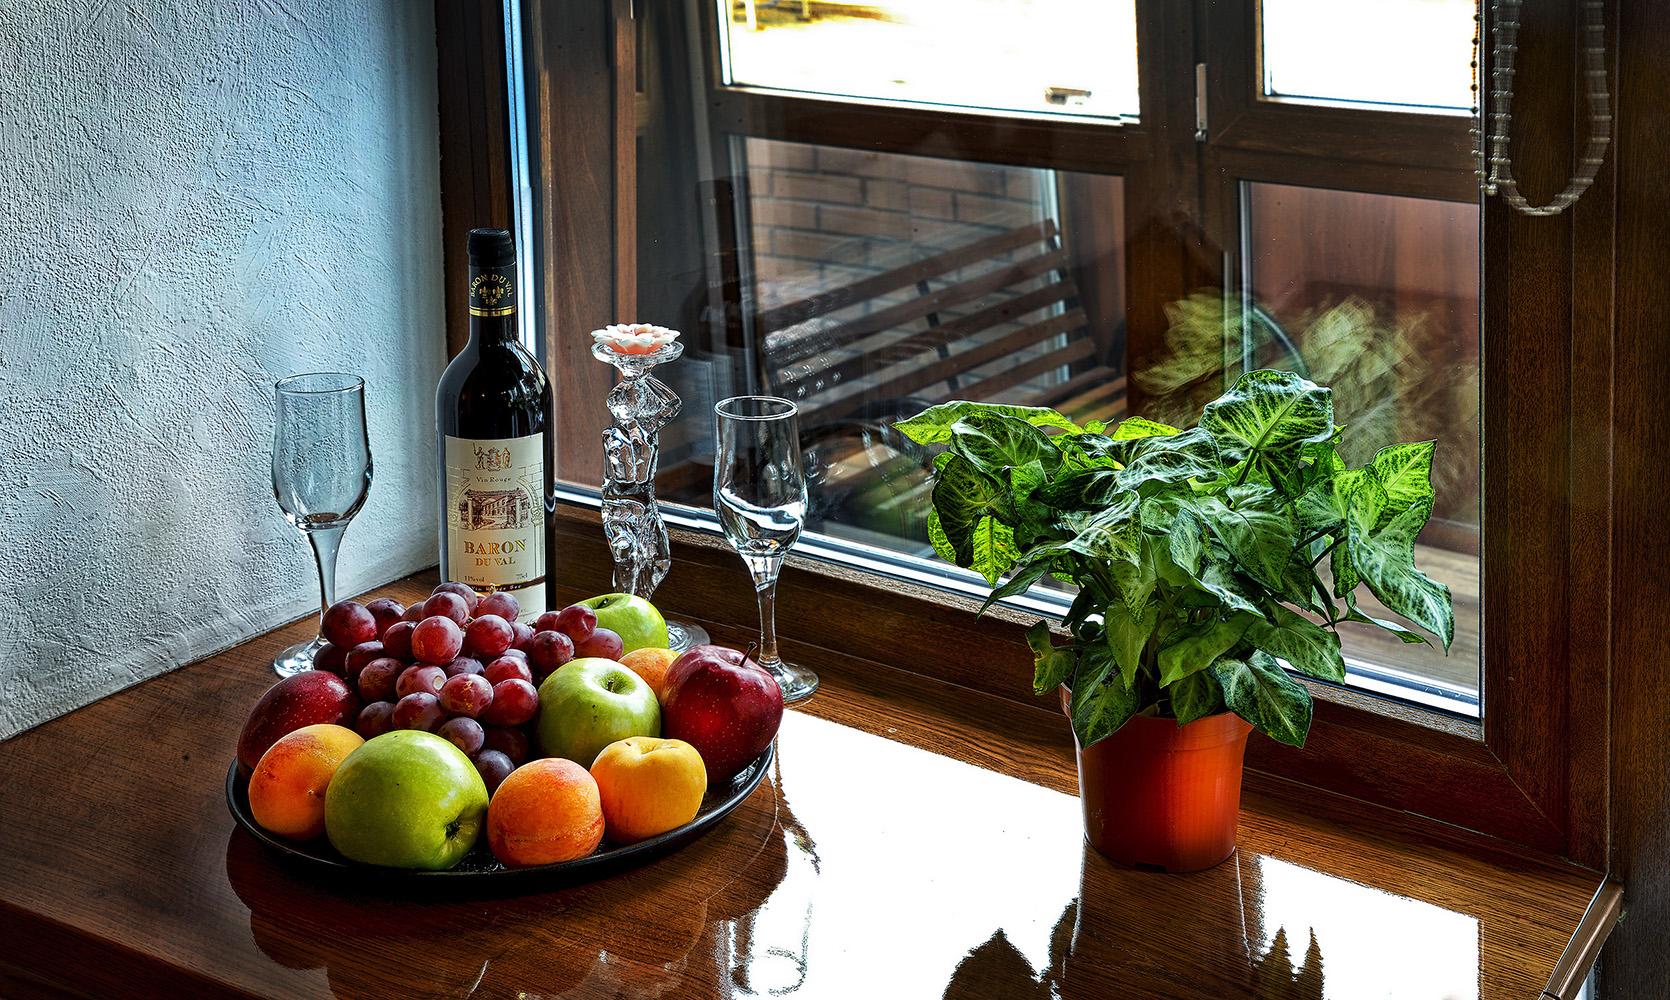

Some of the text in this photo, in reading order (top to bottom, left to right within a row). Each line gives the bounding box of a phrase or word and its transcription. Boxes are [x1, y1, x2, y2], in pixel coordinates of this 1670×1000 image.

[470, 274, 513, 298] BARON DU VAL
[464, 539, 526, 554] BARON
[475, 557, 515, 566] DU VAL
